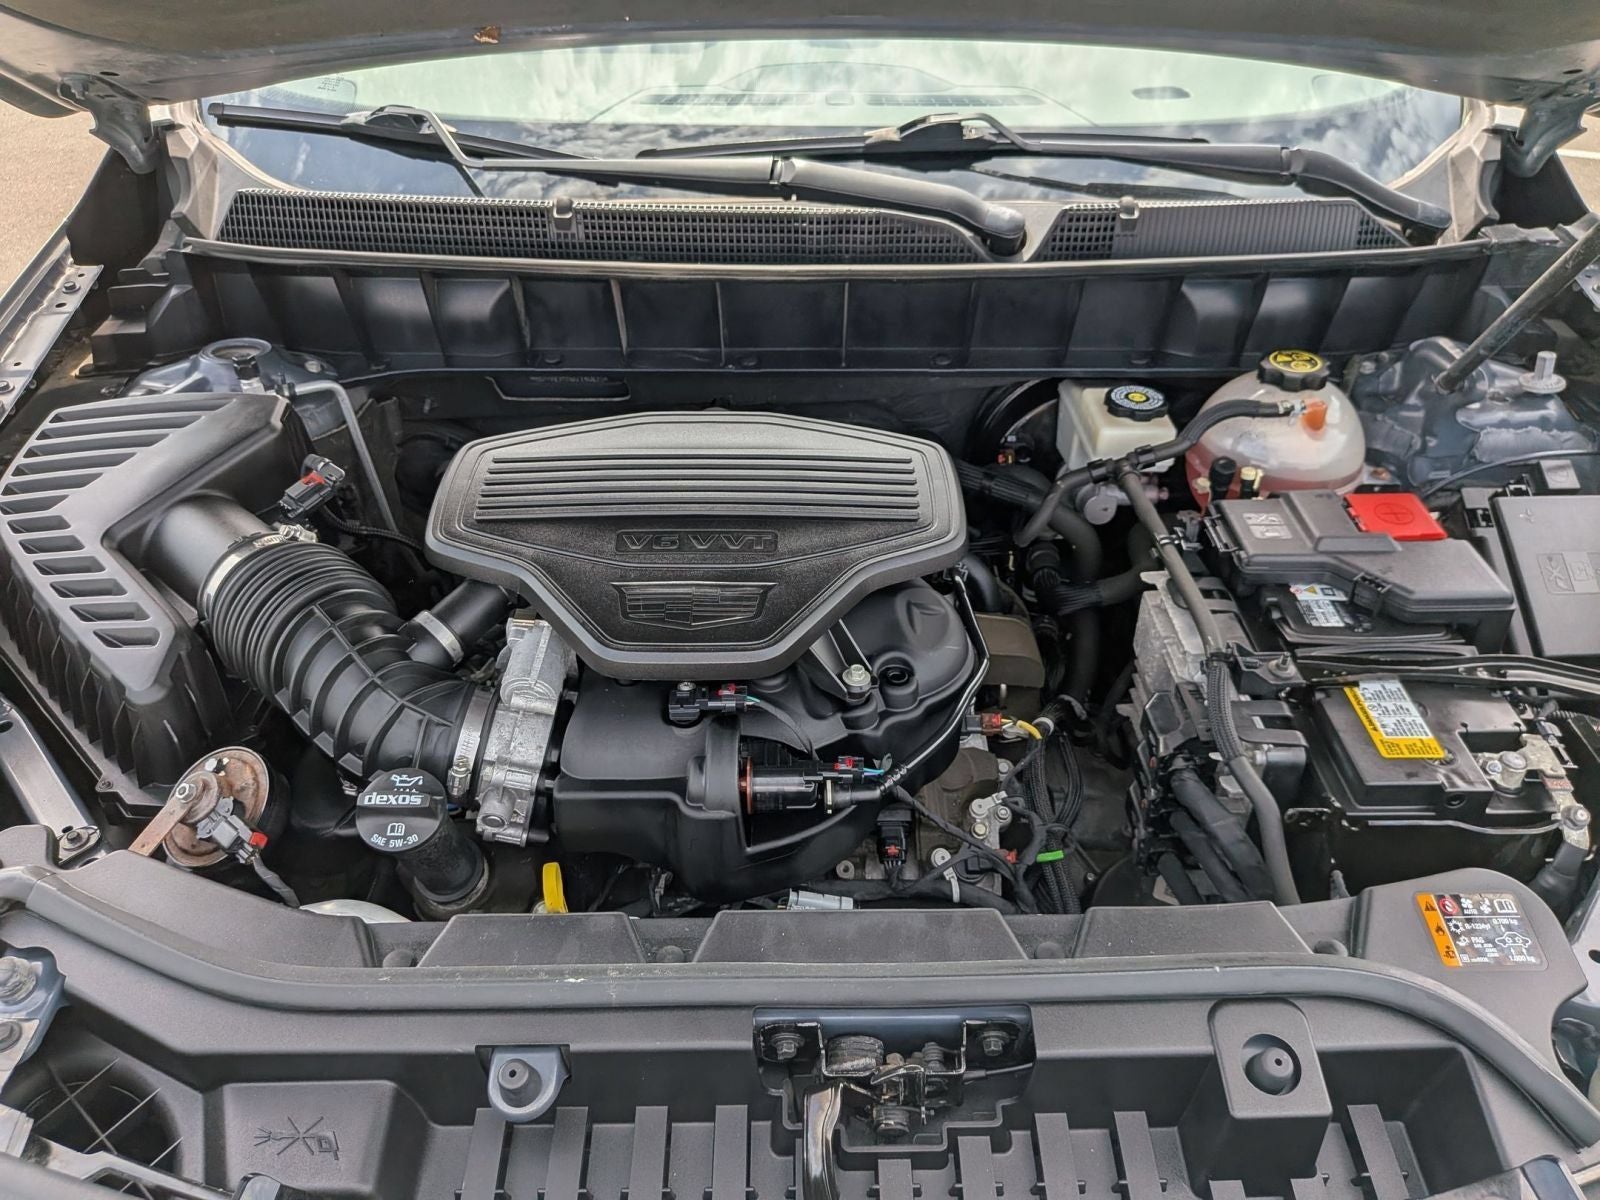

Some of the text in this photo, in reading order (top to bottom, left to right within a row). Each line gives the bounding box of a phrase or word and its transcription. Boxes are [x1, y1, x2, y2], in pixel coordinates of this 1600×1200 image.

[623, 534, 772, 550] V6 VVT
[363, 792, 424, 805] dexos
[370, 833, 419, 848] SAE 5W-30
